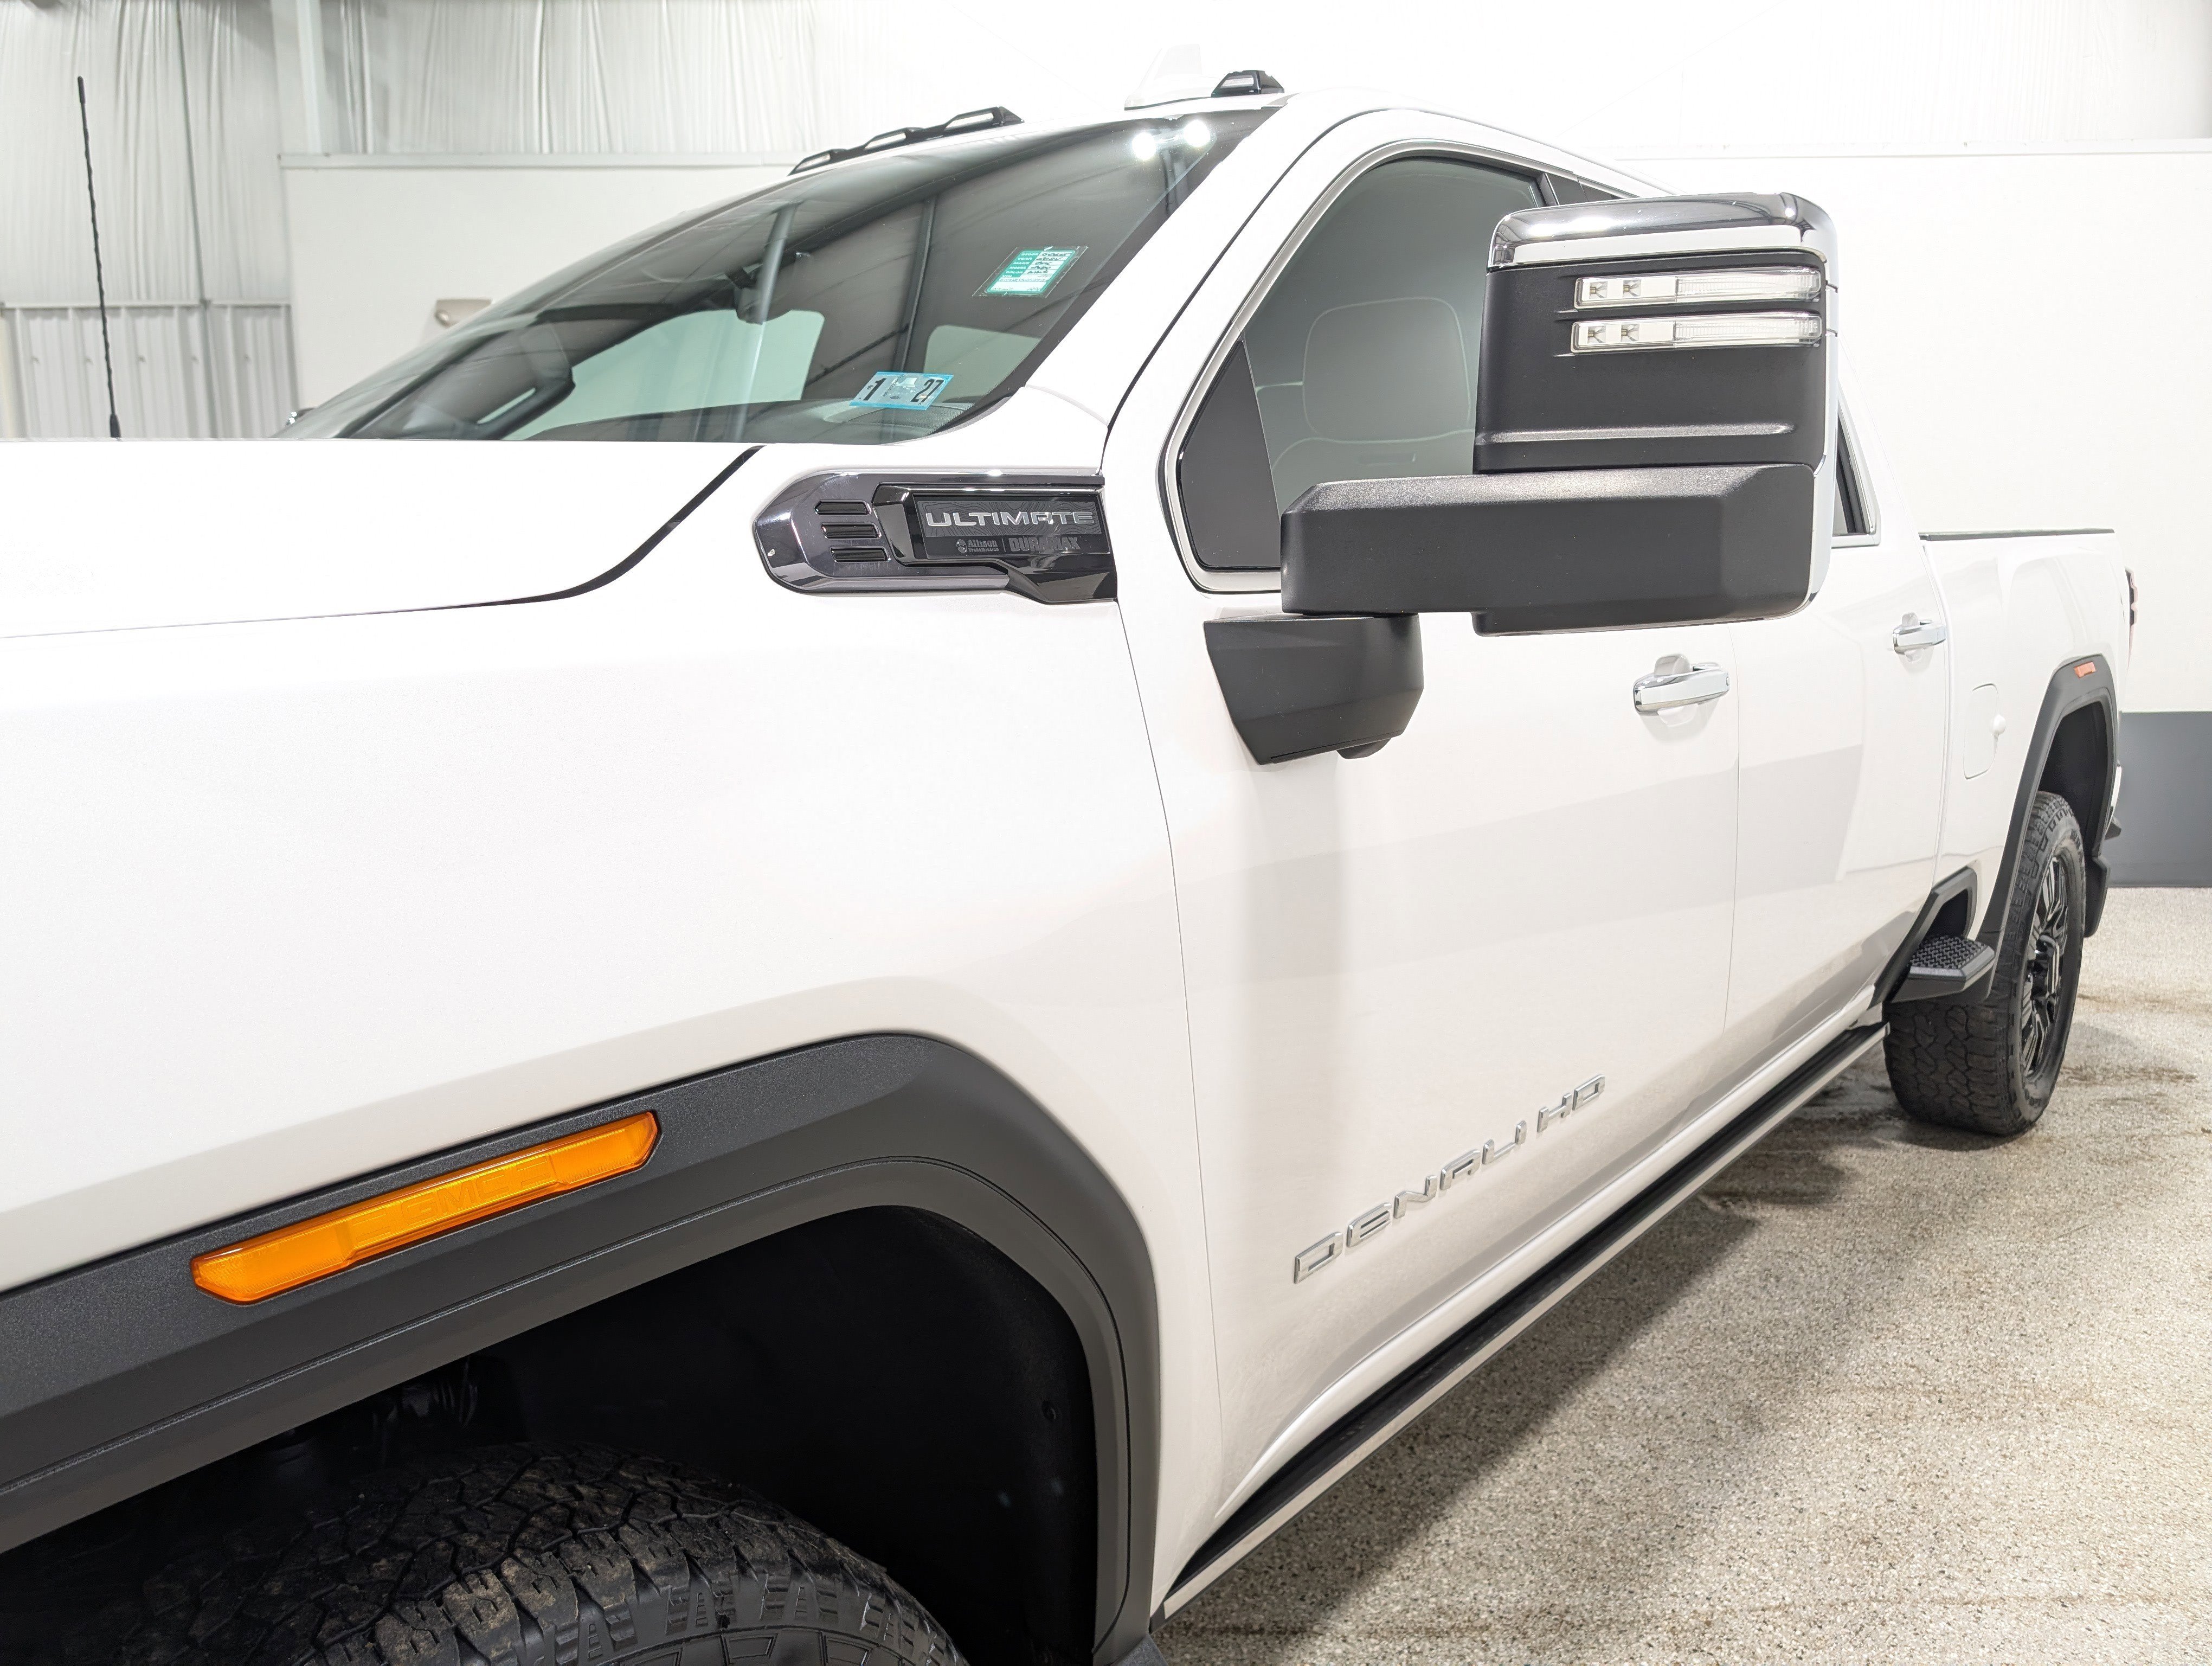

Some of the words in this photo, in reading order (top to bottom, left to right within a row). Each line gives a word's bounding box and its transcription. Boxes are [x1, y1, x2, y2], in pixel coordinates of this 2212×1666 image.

[863, 377, 886, 401] 1
[910, 379, 944, 403] 27
[925, 511, 1095, 527] ULTIMATE
[968, 539, 998, 548] Allison
[1008, 536, 1081, 552] DURAMAX
[1294, 1120, 1527, 1284] DENALI
[1537, 1074, 1605, 1132] HD
[400, 1170, 510, 1226] GMC
